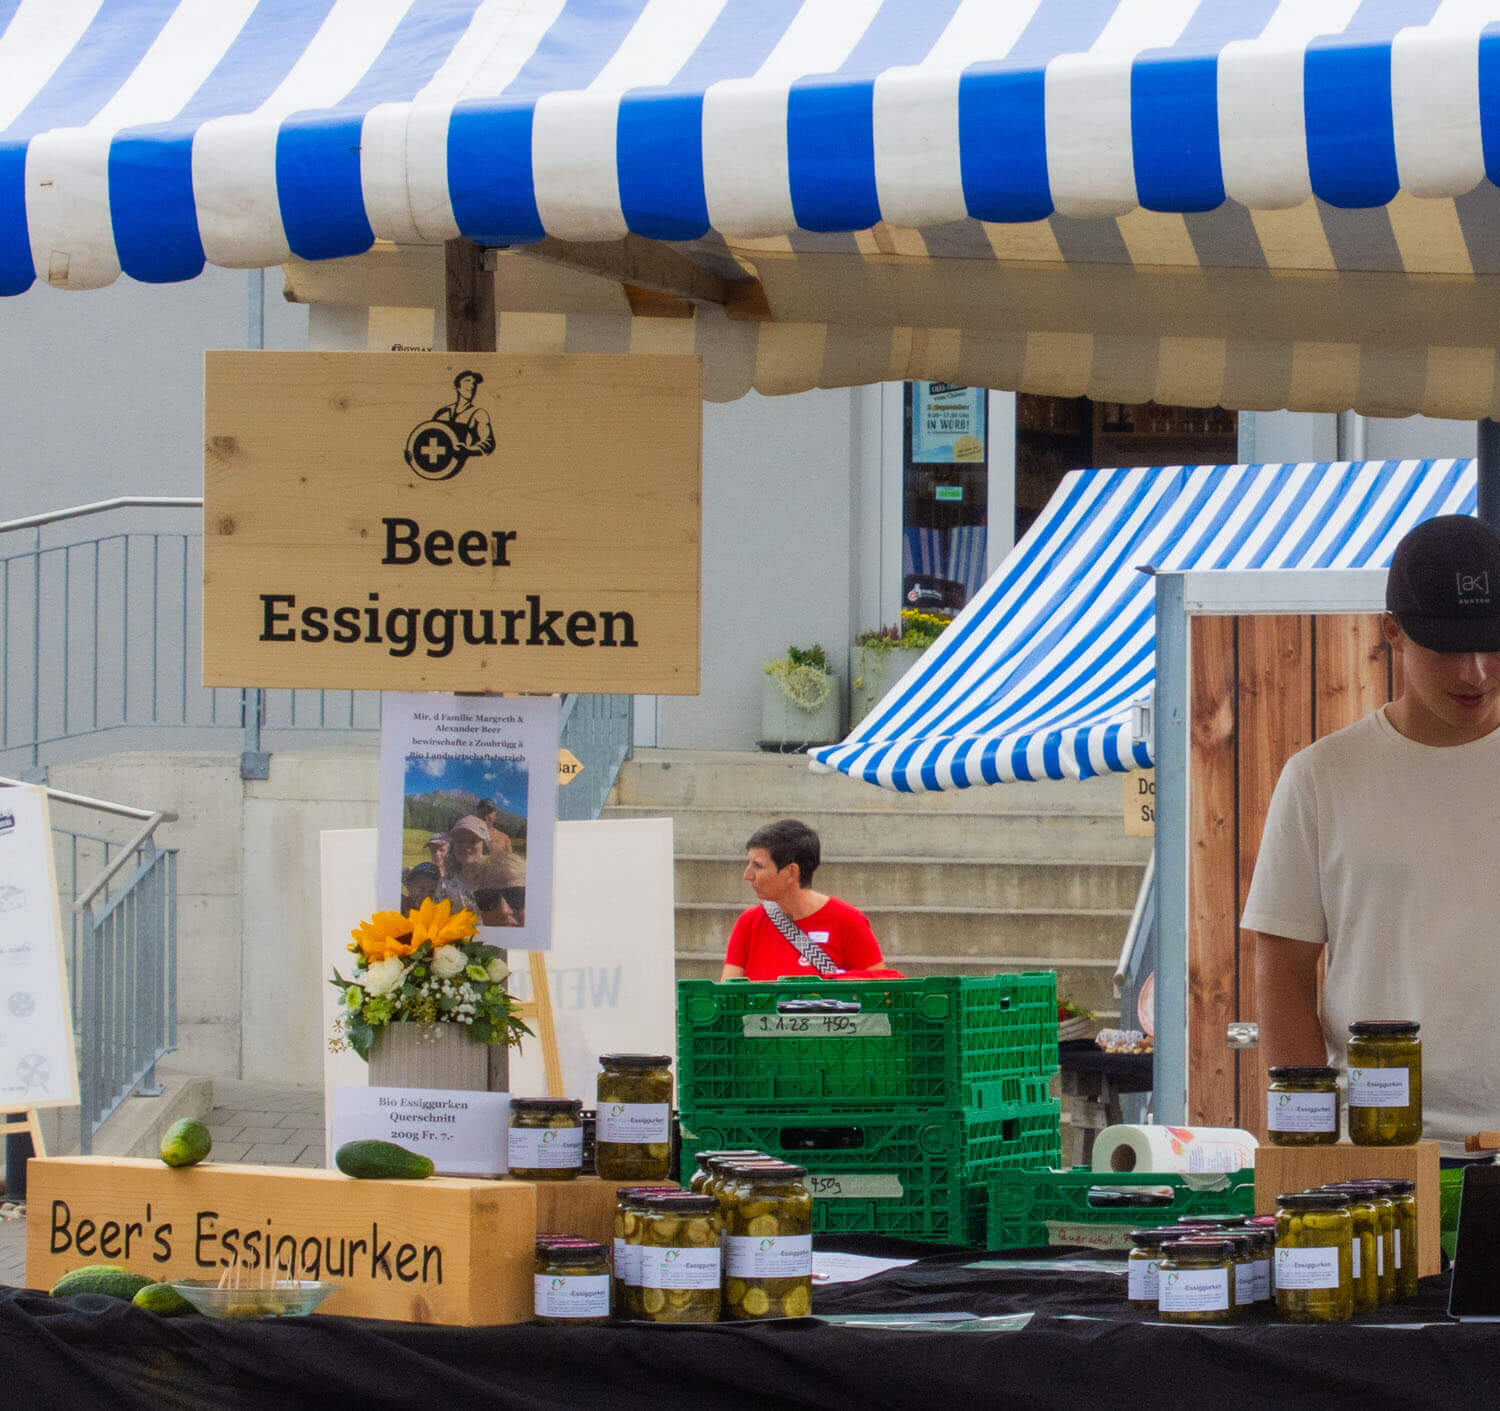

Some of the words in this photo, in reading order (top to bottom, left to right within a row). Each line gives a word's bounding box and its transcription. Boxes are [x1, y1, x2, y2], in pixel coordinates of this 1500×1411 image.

[927, 419, 937, 430] IN
[381, 517, 517, 567] Beer
[258, 592, 639, 658] Essiggurken
[441, 713, 473, 722] Familie
[474, 714, 516, 724] Margreth
[435, 725, 480, 734] Alexander
[481, 725, 502, 734] Beer
[560, 763, 578, 774] ar
[823, 1016, 857, 1034] 450g
[379, 1097, 397, 1106] Bio
[400, 1098, 468, 1110] Essiggurken
[390, 1112, 456, 1123] Querschnitt
[391, 1131, 420, 1141] 200g
[422, 1130, 438, 1140] Fr.
[811, 1177, 842, 1194] 450g
[50, 1199, 173, 1263] Beer's
[195, 1210, 443, 1285] Essiggurken
